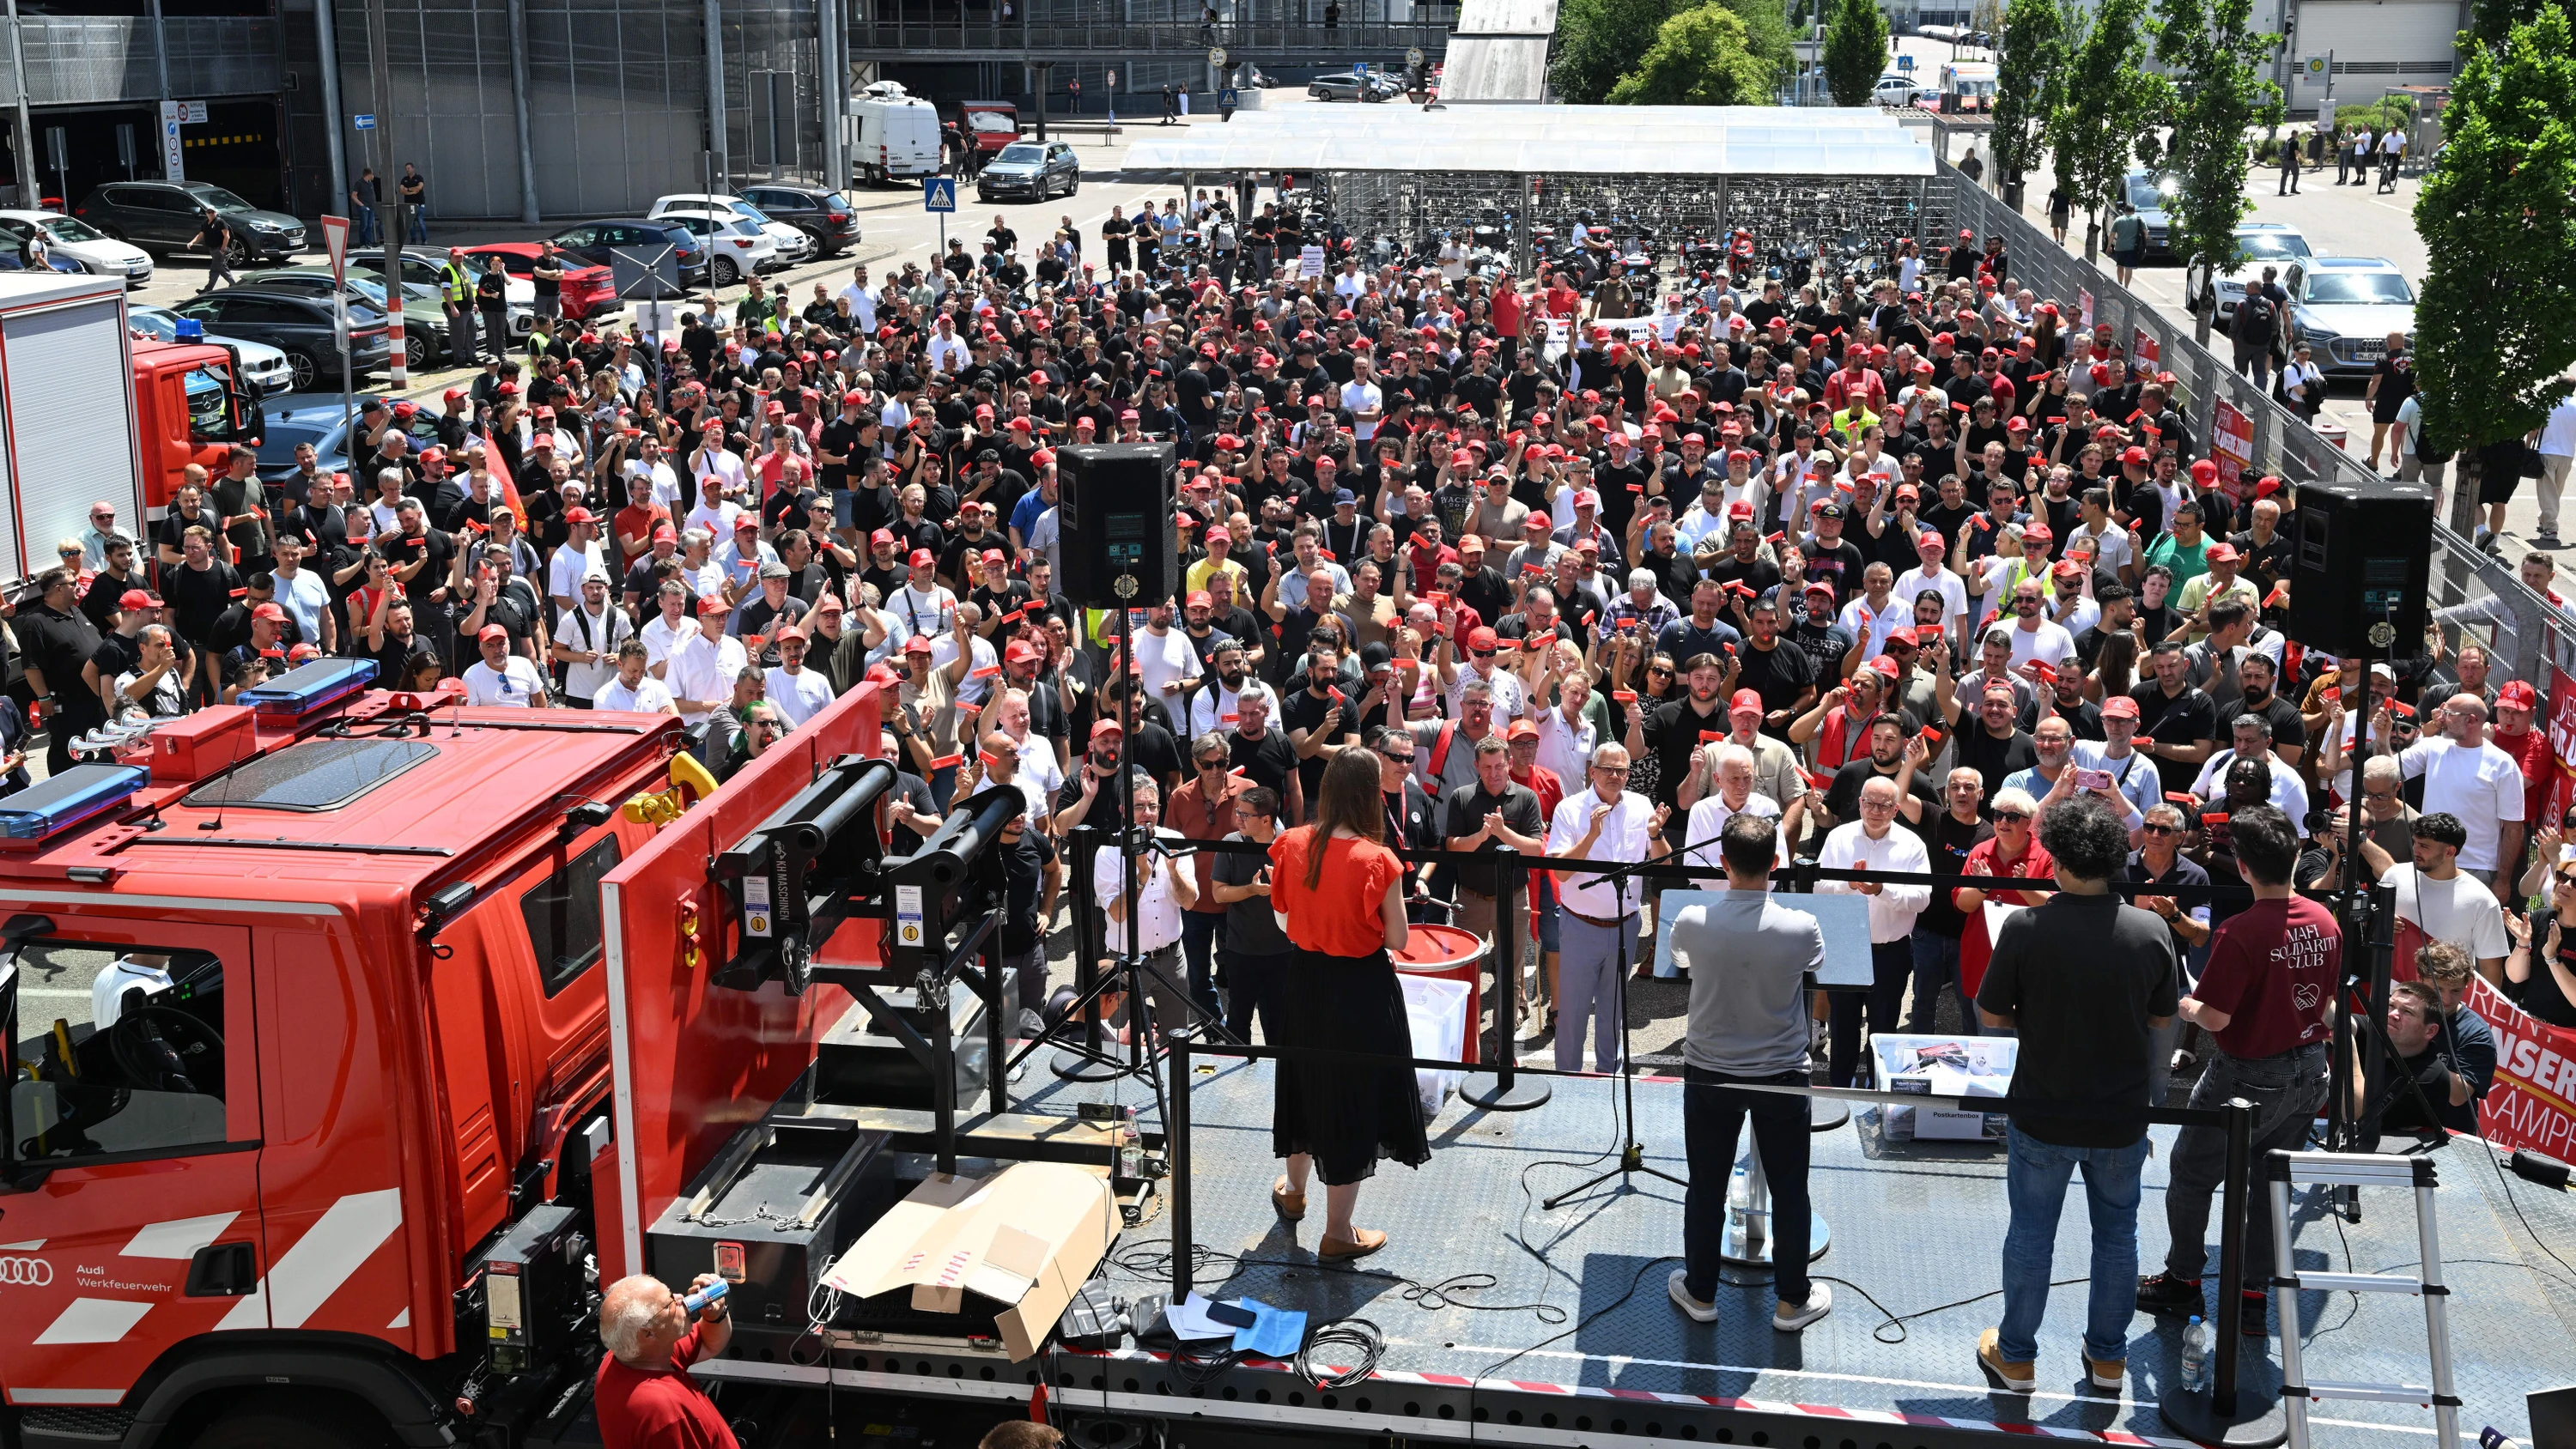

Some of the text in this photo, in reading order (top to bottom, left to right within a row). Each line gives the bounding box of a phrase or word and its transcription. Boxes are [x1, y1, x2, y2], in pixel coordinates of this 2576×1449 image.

[1440, 496, 1471, 505] WACK
[1808, 560, 1845, 571] THRILLER
[2549, 718, 2567, 757] FÜR
[775, 860, 790, 921] KH MASCHINEN
[2287, 924, 2319, 943] MAFI
[2269, 935, 2337, 962] SOLIDARITY
[2287, 953, 2324, 969] CLUB
[2486, 1022, 2576, 1107] NSER
[1933, 1111, 1980, 1119] Postkartenbox
[76, 1264, 105, 1276] Audi
[76, 1277, 173, 1293] Werkfeuerwehr
